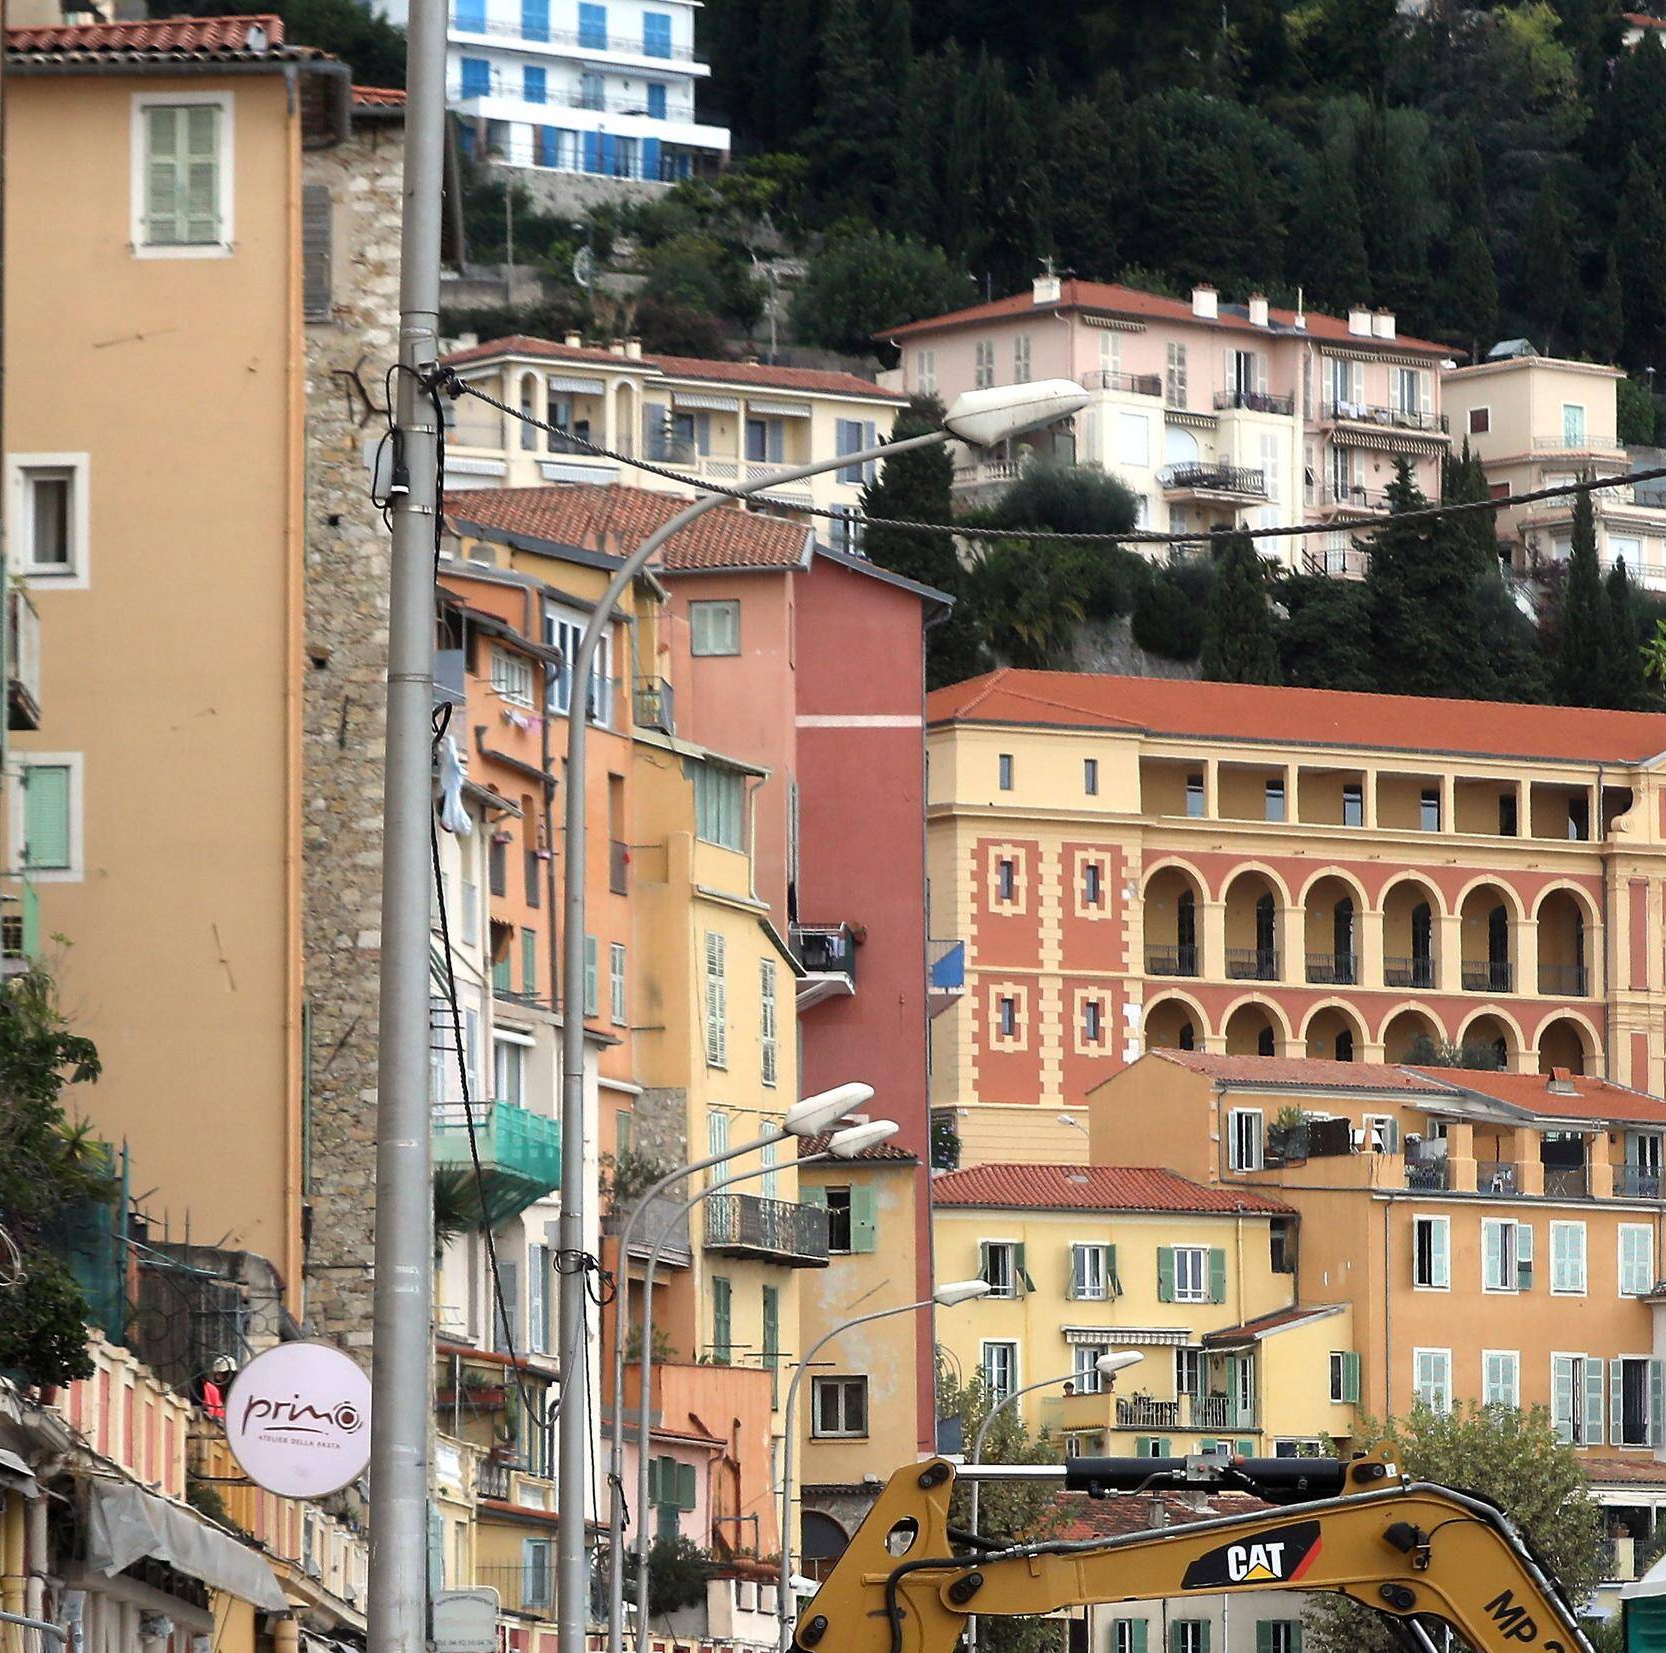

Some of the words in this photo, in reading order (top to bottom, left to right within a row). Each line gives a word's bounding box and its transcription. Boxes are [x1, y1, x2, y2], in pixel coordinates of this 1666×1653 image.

[241, 1393, 364, 1436] primo
[290, 1437, 314, 1447] DELLA
[1226, 1541, 1286, 1582] CAT
[1483, 1588, 1538, 1643] MP
